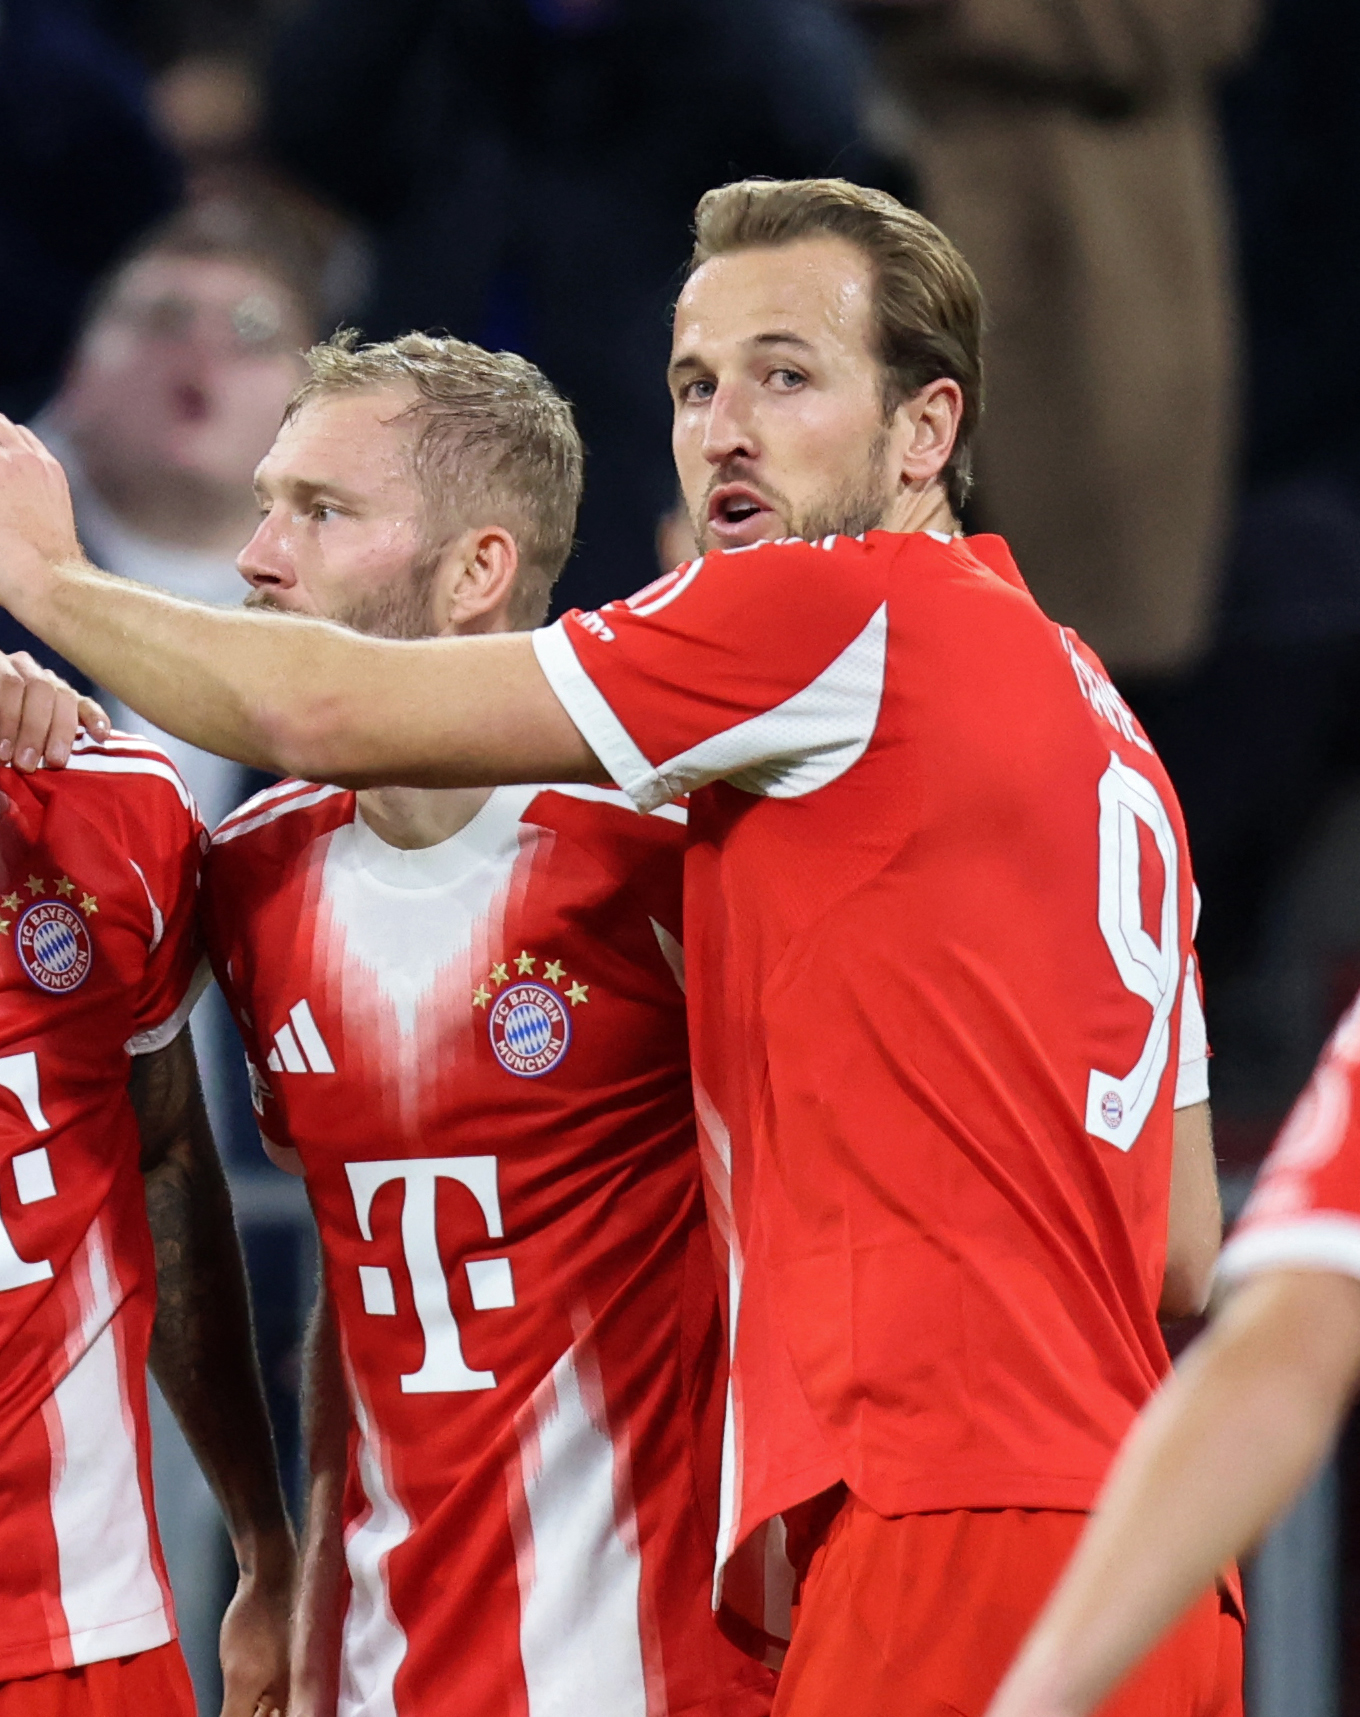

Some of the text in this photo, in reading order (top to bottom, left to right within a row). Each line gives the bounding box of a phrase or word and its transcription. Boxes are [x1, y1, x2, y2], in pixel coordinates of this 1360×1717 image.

[22, 907, 82, 946] FC BAYERN
[1085, 750, 1180, 1153] 9
[495, 989, 562, 1025] FC BAYERN
[344, 1155, 505, 1394] T
